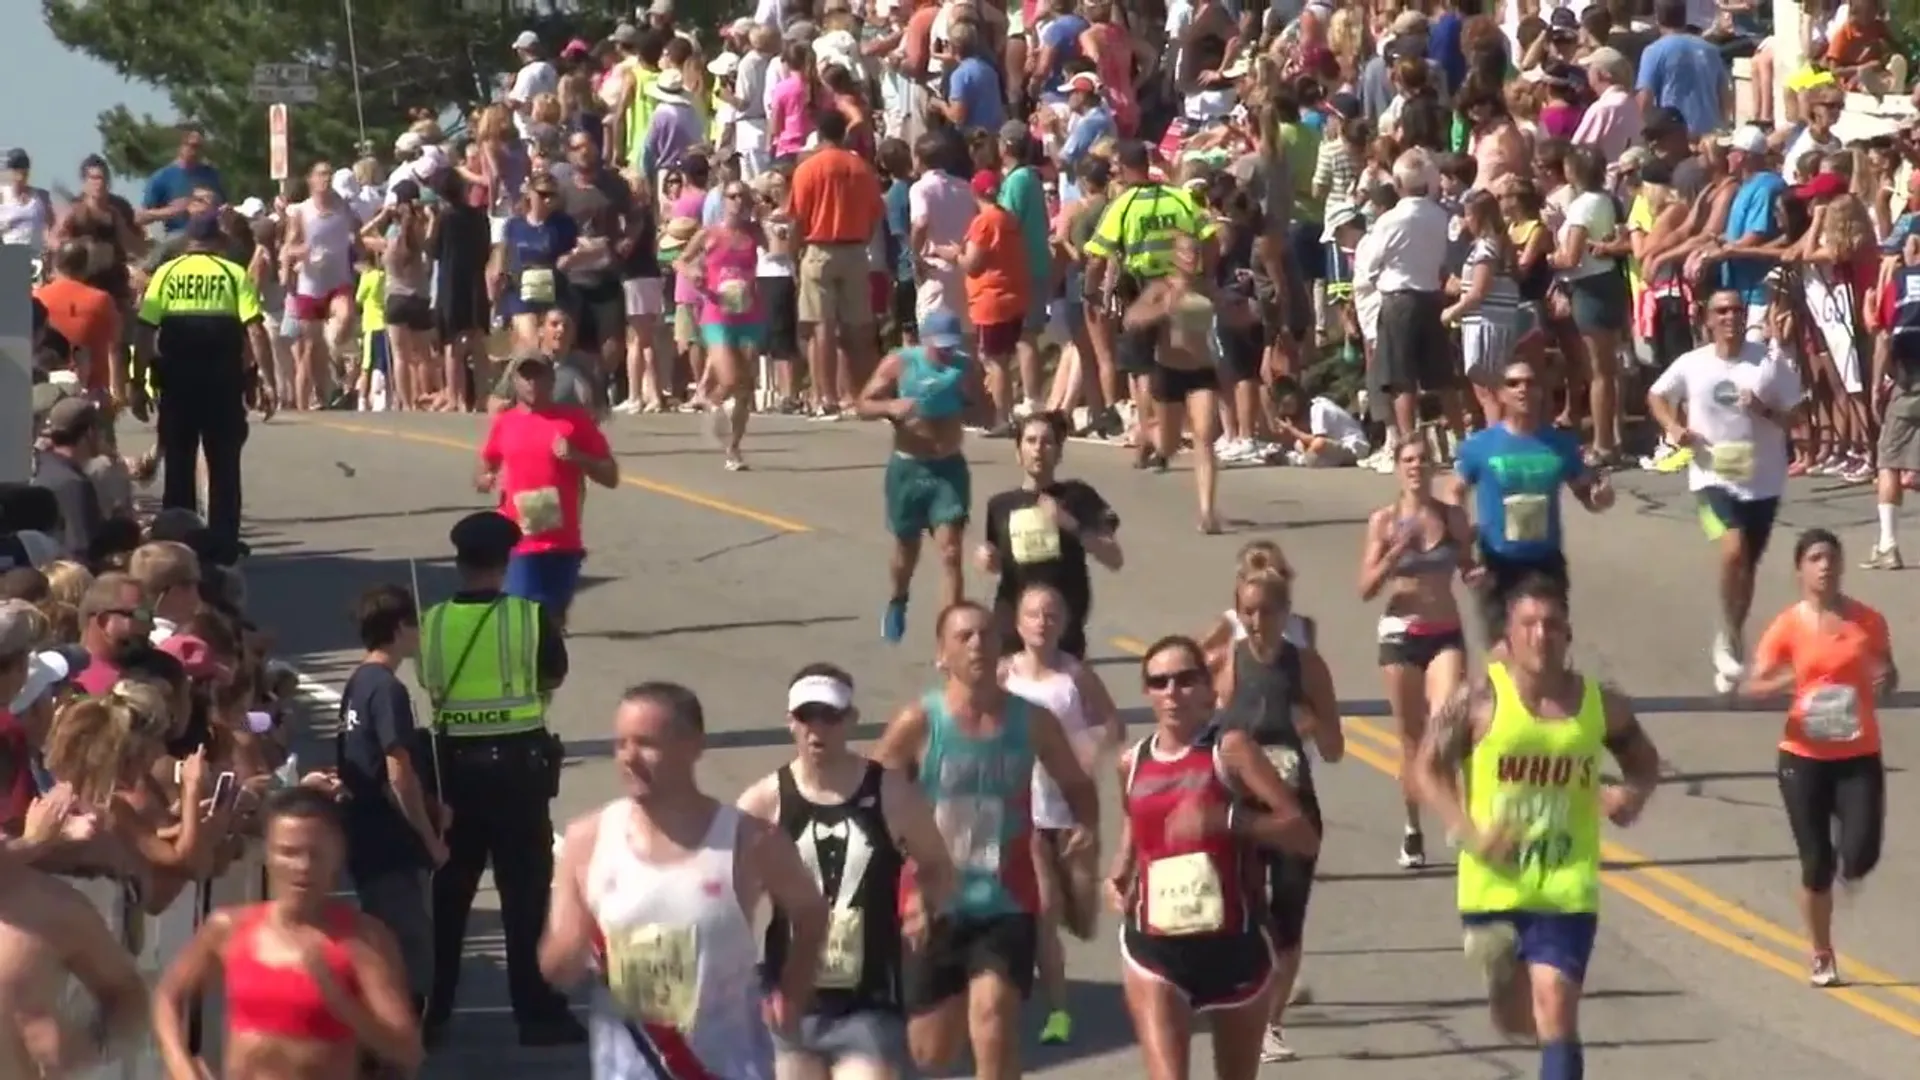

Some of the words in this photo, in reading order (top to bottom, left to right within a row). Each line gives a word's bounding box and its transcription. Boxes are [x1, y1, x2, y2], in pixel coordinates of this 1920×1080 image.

[167, 273, 226, 300] SHERIFF
[442, 710, 513, 725] POLICE
[1497, 755, 1595, 788] WHO'S
